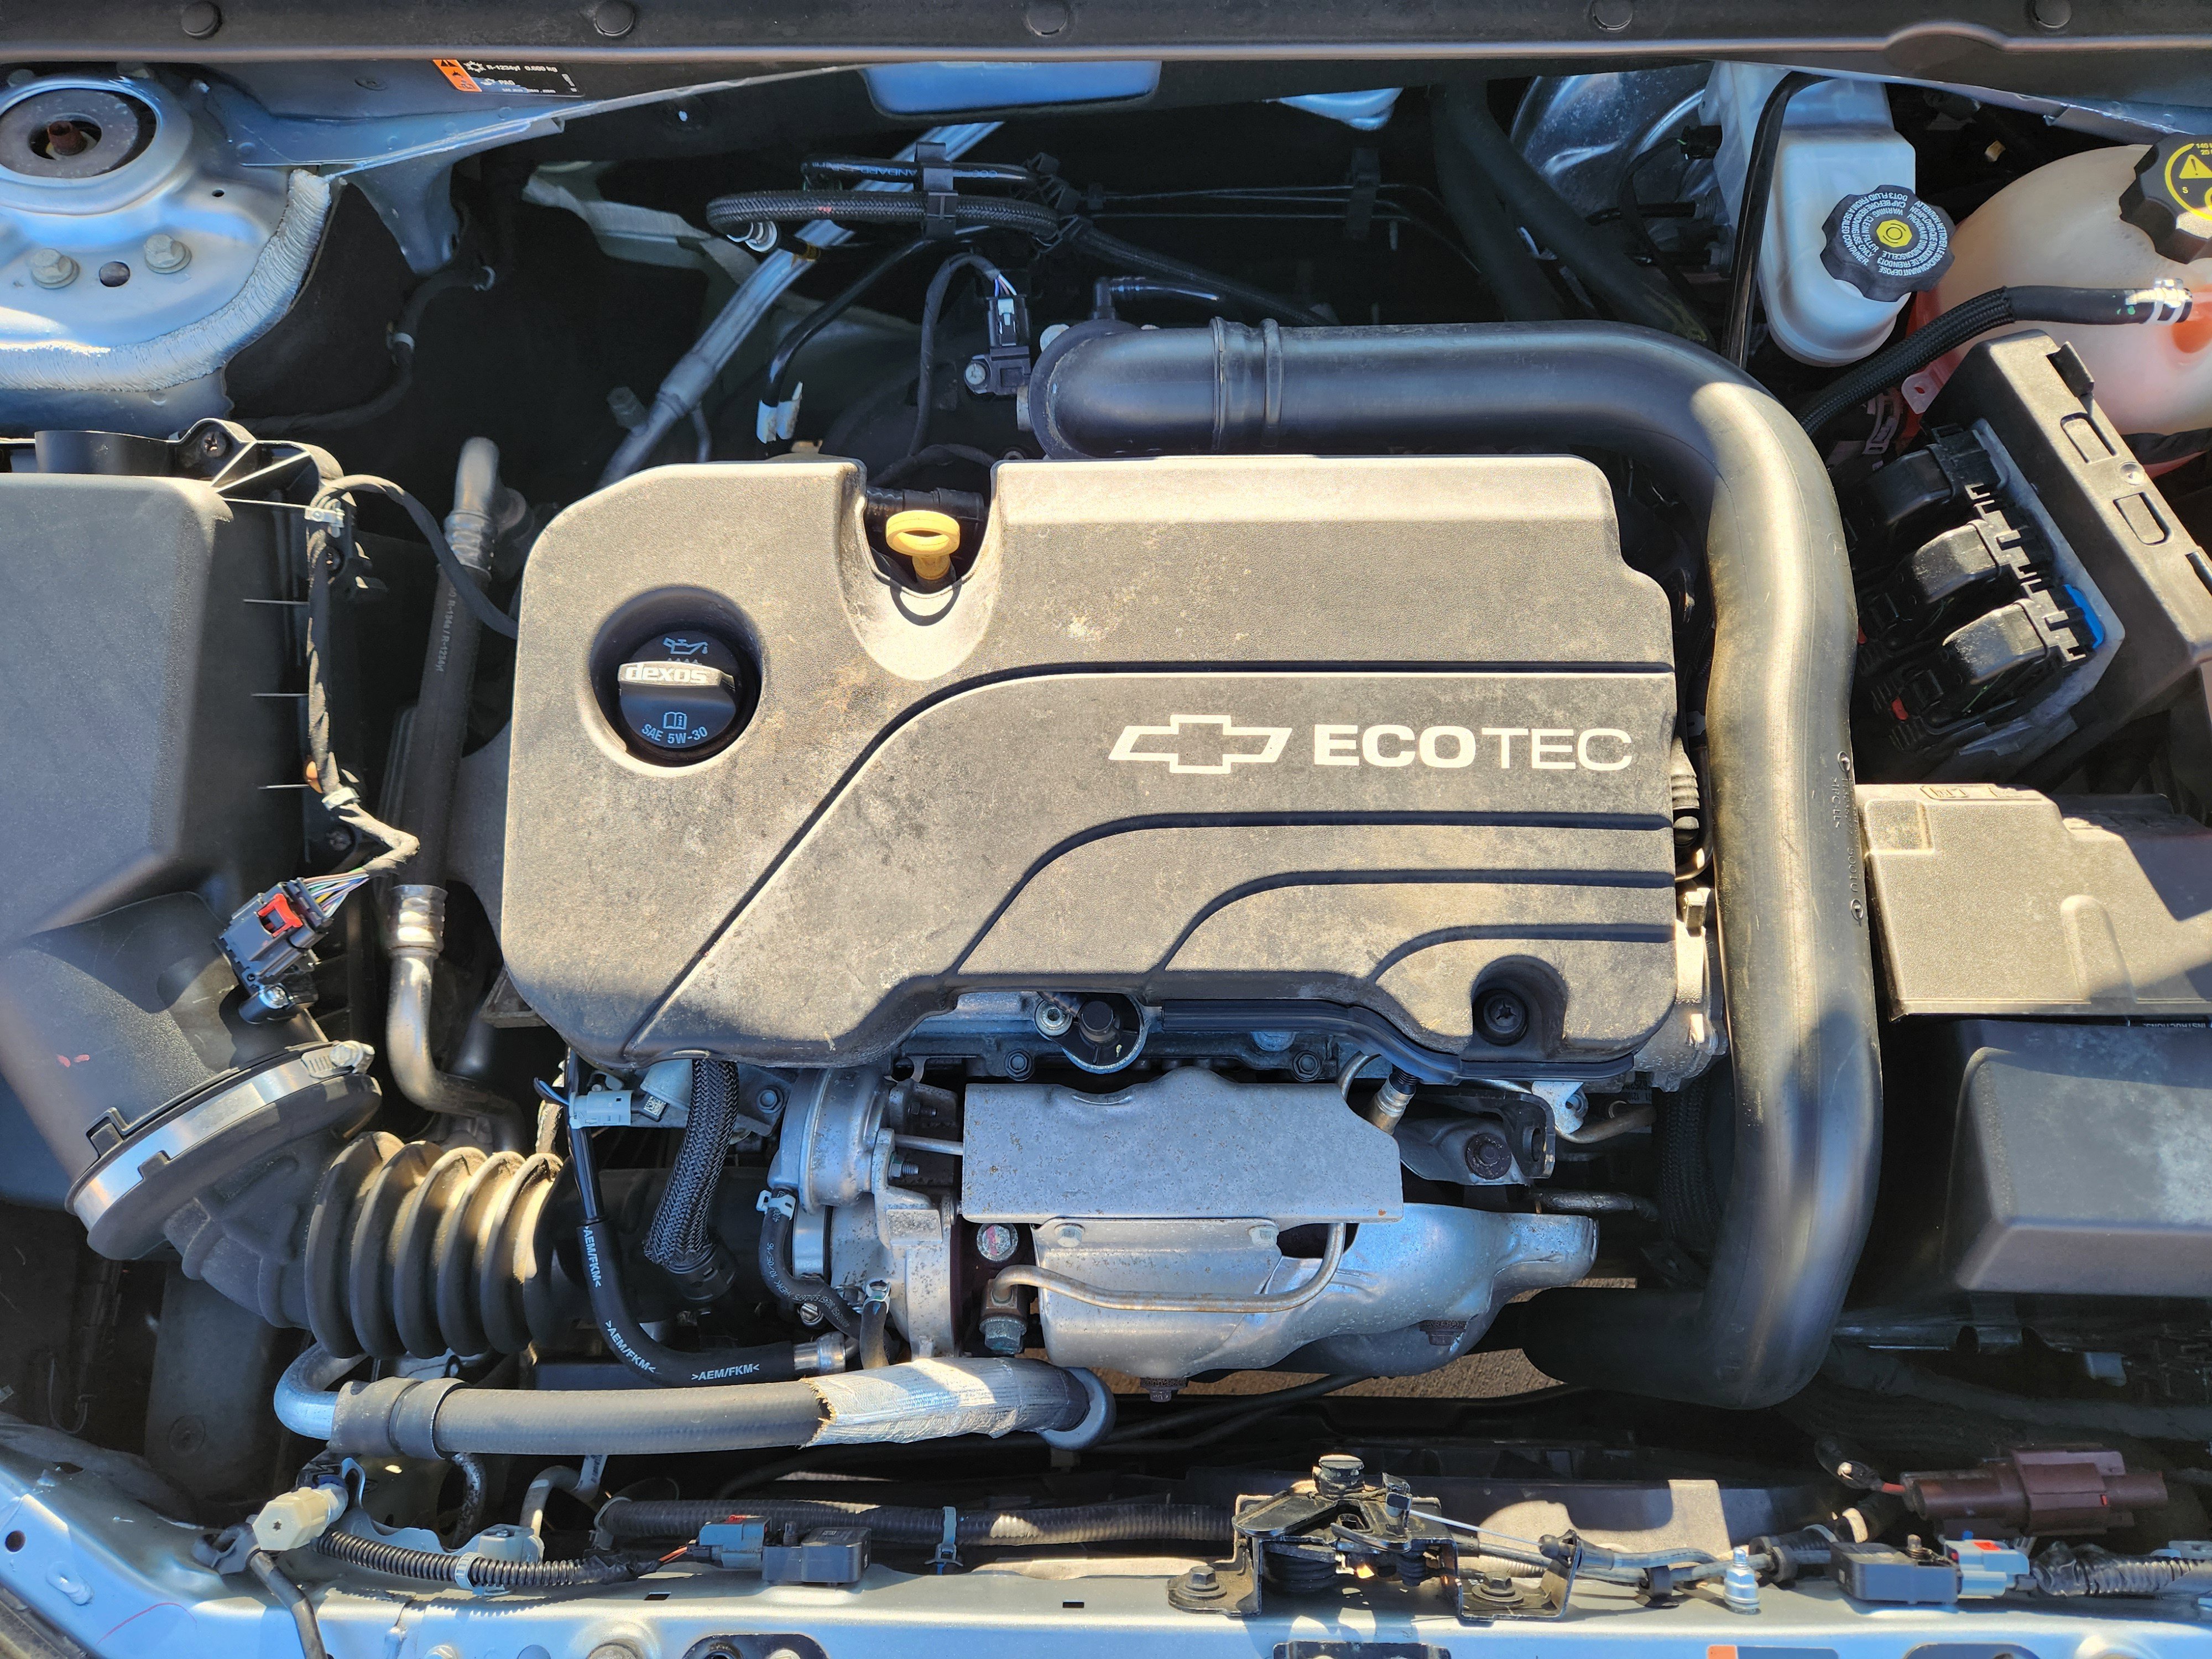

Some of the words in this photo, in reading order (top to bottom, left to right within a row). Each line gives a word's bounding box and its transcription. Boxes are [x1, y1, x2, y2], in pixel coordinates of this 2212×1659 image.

[1851, 196, 1870, 211] FROM
[1867, 192, 1888, 201] FLUID
[1888, 192, 1908, 202] DOT3
[1891, 200, 1906, 208] CAP
[1865, 200, 1891, 211] BEFORE
[1841, 212, 1854, 234] SEALED
[1851, 207, 1869, 234] REMOVING
[1861, 216, 1874, 233] CLEAN
[1907, 213, 1928, 240] PROVENANT
[1852, 234, 1864, 245] USE
[1929, 231, 1938, 242] QUE
[1936, 222, 1948, 247] NETTOYER
[1858, 244, 1875, 258] ONLY
[1862, 234, 1879, 253] FILLER
[1936, 247, 1946, 255] LE
[1877, 257, 1893, 267] DOT3
[1905, 248, 1922, 259] BIDON
[1916, 247, 1935, 264] LIQUIDE
[1903, 266, 1922, 276] AVANT
[1910, 258, 1920, 267] DE
[1921, 253, 1943, 272] BOUCHON
[625, 663, 708, 684] dexos
[641, 723, 664, 742] SAE
[667, 727, 708, 744] 5W-30
[1314, 724, 1633, 771] ECOTEC
[584, 1225, 603, 1288] >AEM/FKM<
[766, 1242, 778, 1279] 10/05/16
[605, 1319, 658, 1374] >AEM/FKM<
[691, 1363, 760, 1381] >AEM/FKM<
